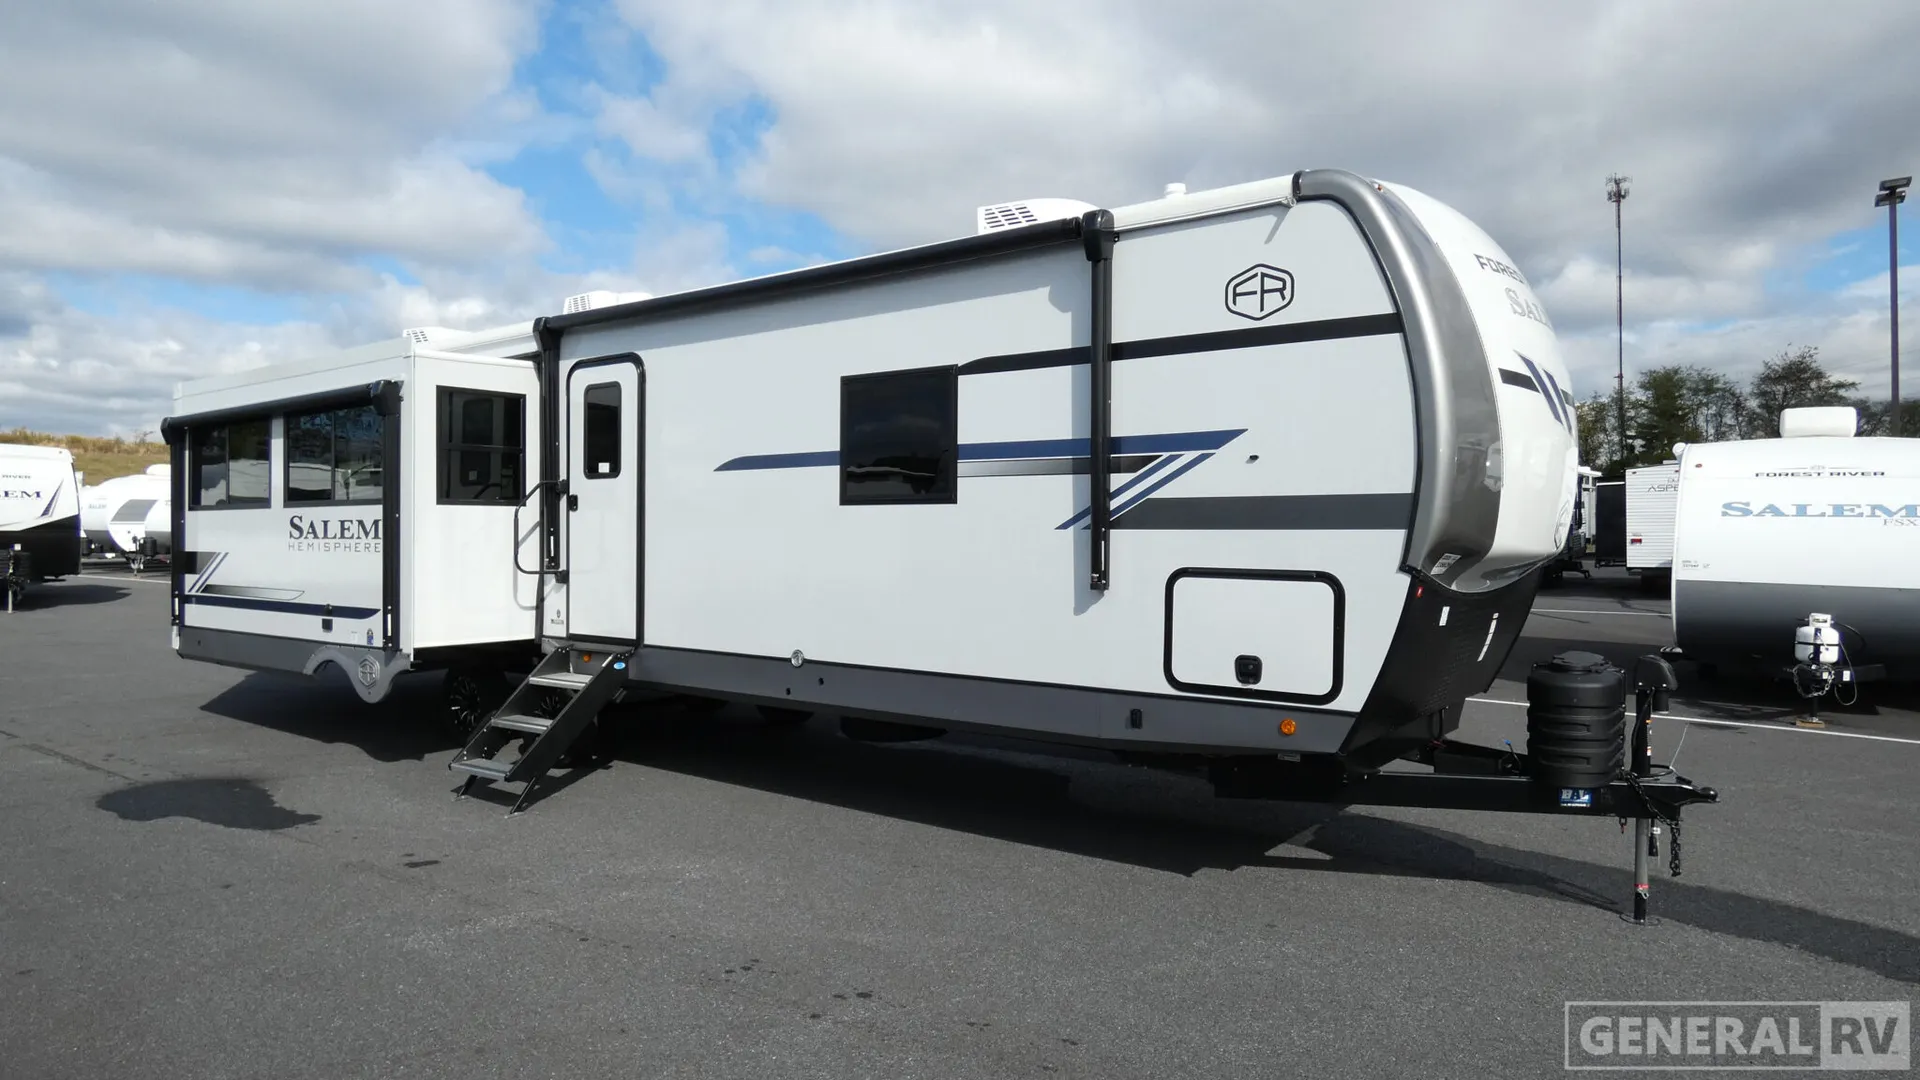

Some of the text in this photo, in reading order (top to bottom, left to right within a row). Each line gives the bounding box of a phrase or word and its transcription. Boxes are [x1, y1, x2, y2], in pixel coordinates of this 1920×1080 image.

[1232, 271, 1287, 313] FR
[0, 490, 41, 498] EM
[1720, 502, 1920, 518] SALEM
[289, 515, 382, 540] SALEM
[288, 542, 381, 553] HEMISPHERE
